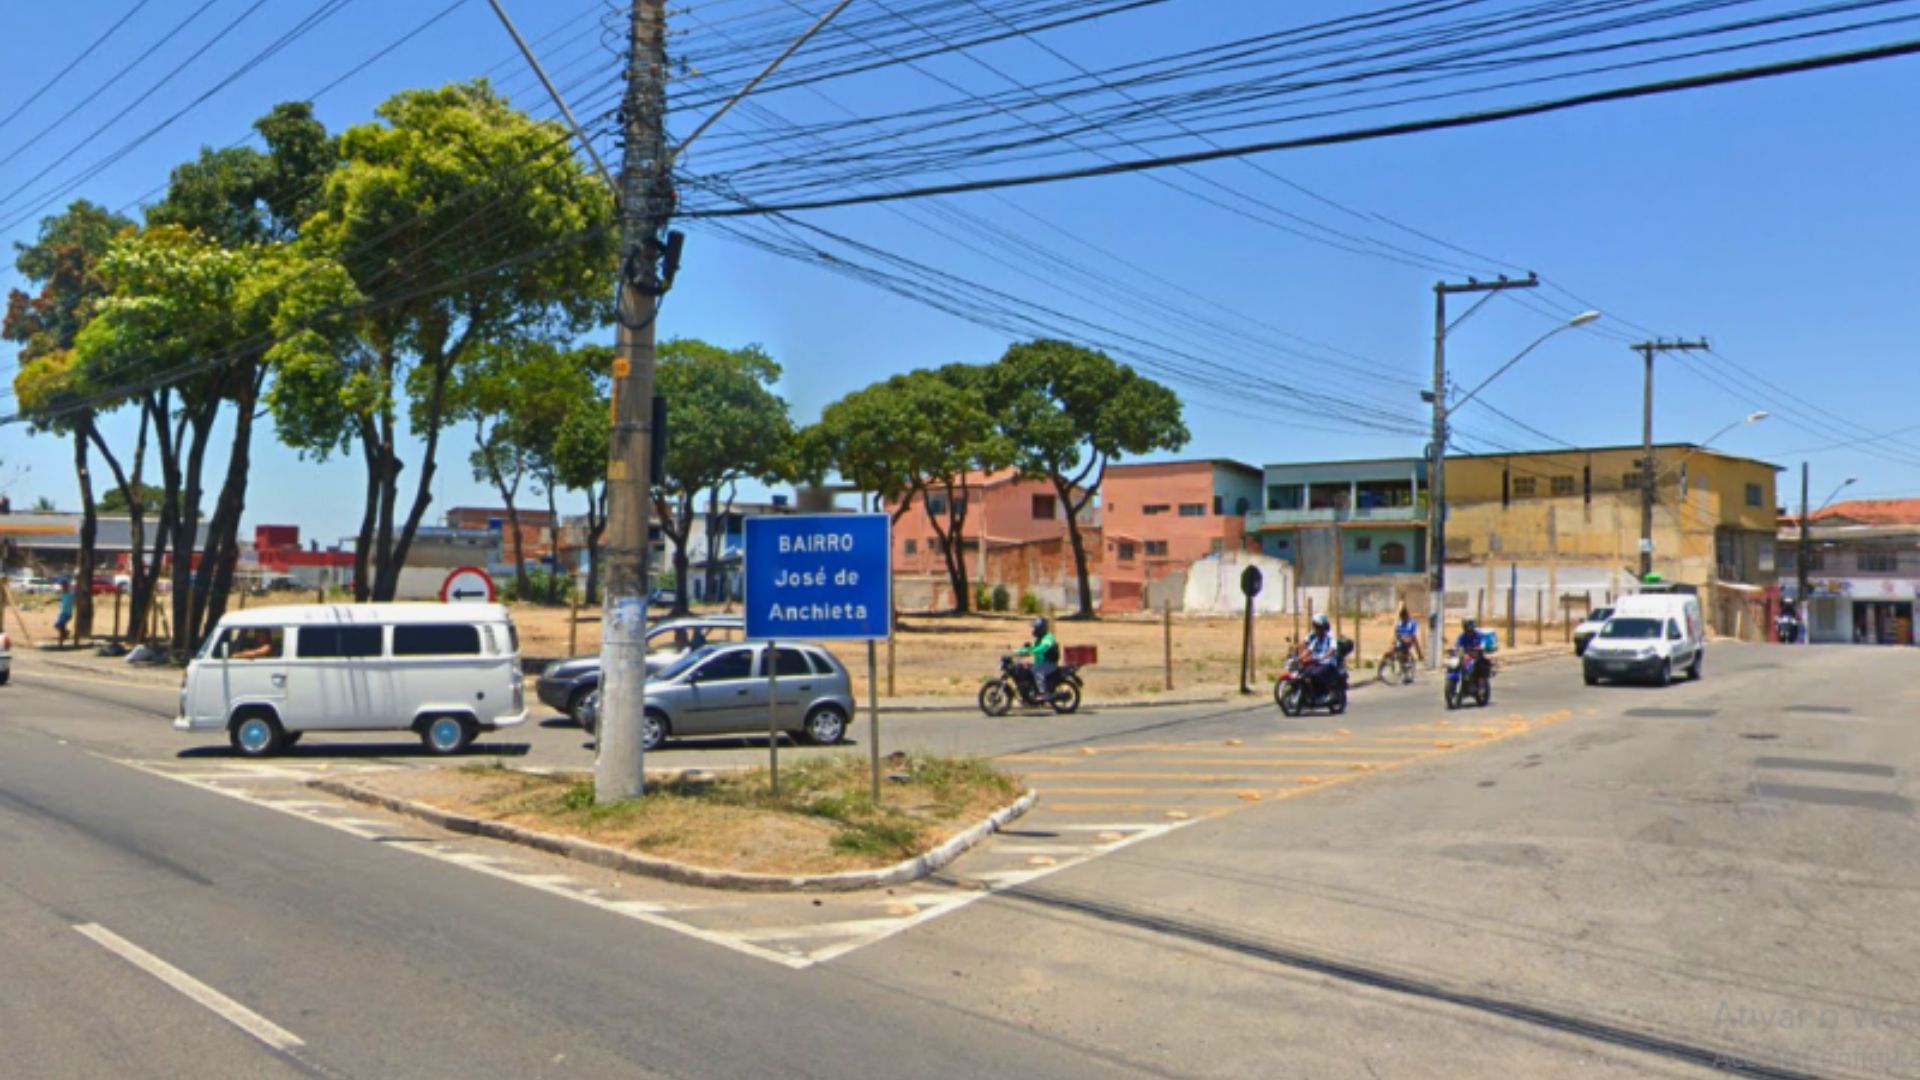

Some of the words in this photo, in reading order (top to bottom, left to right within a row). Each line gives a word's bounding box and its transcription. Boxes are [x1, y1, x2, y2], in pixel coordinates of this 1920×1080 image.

[778, 533, 854, 553] BAIRRO
[774, 566, 827, 587] José
[834, 568, 860, 586] de
[767, 602, 868, 621] Anchieta
